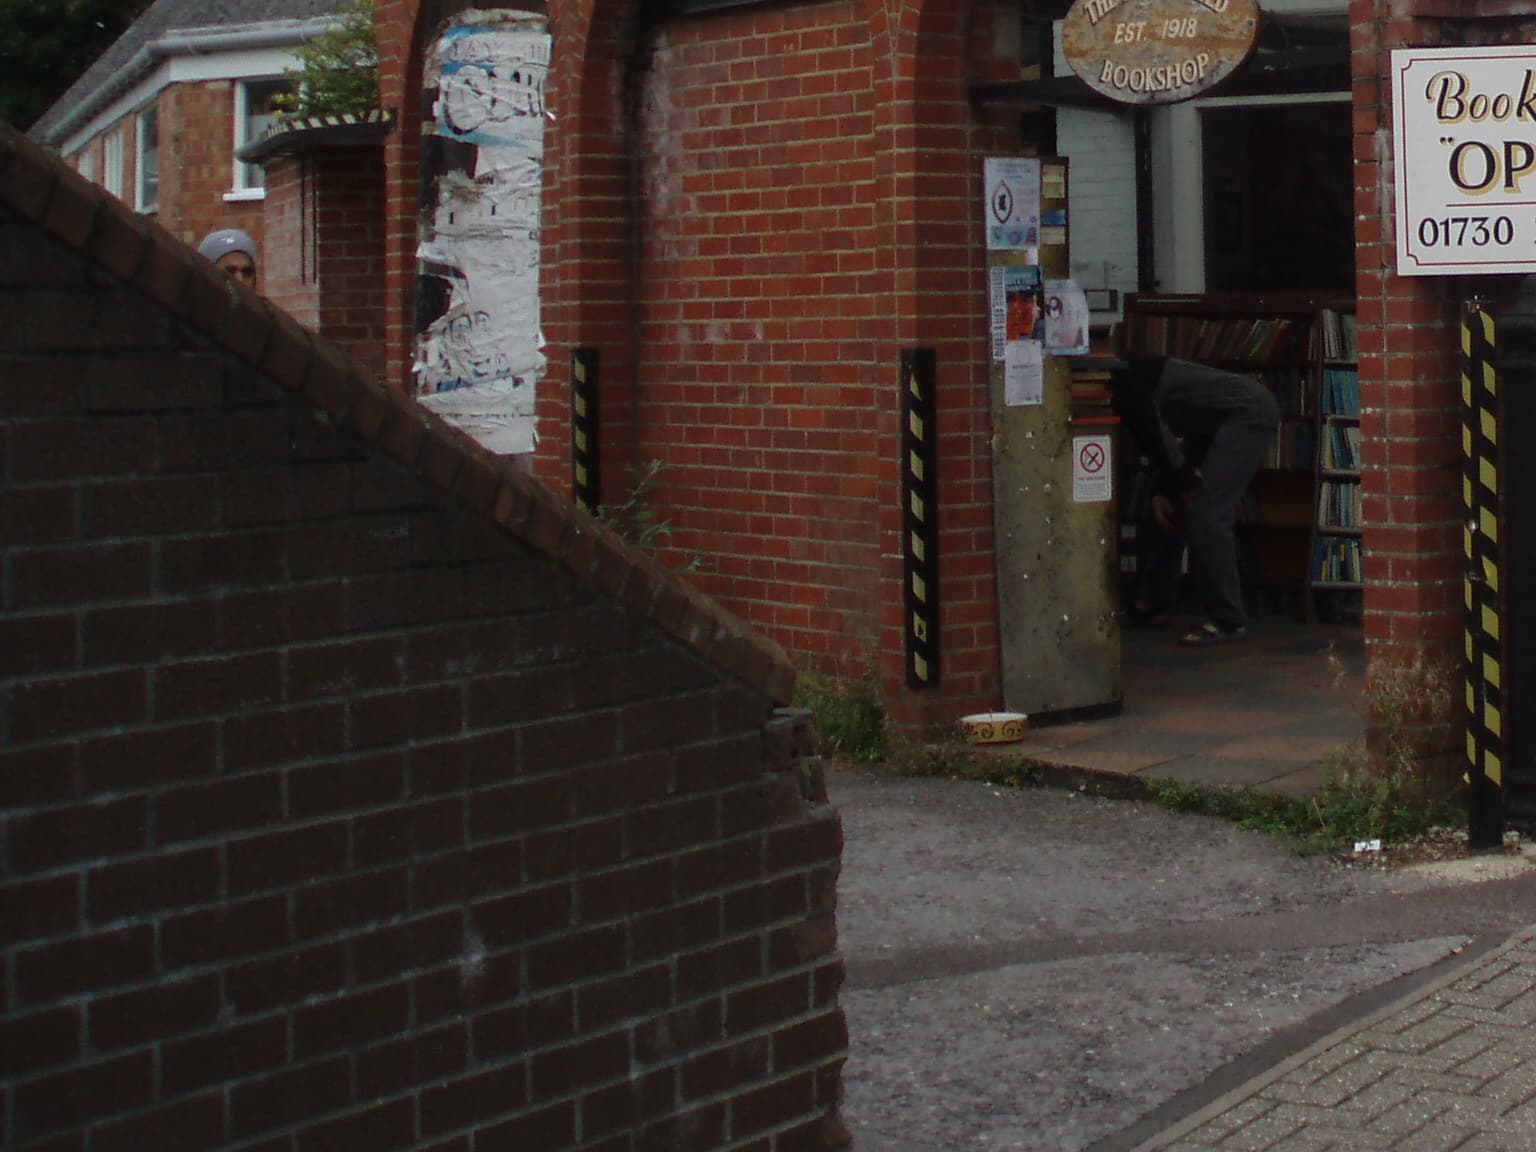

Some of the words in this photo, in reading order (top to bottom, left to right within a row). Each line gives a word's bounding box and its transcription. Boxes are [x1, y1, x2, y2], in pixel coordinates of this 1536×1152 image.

[1114, 21, 1147, 44] EST.
[1162, 17, 1198, 39] 1918
[1100, 52, 1210, 92] BOOKSHOP
[1418, 216, 1514, 247] 01730
